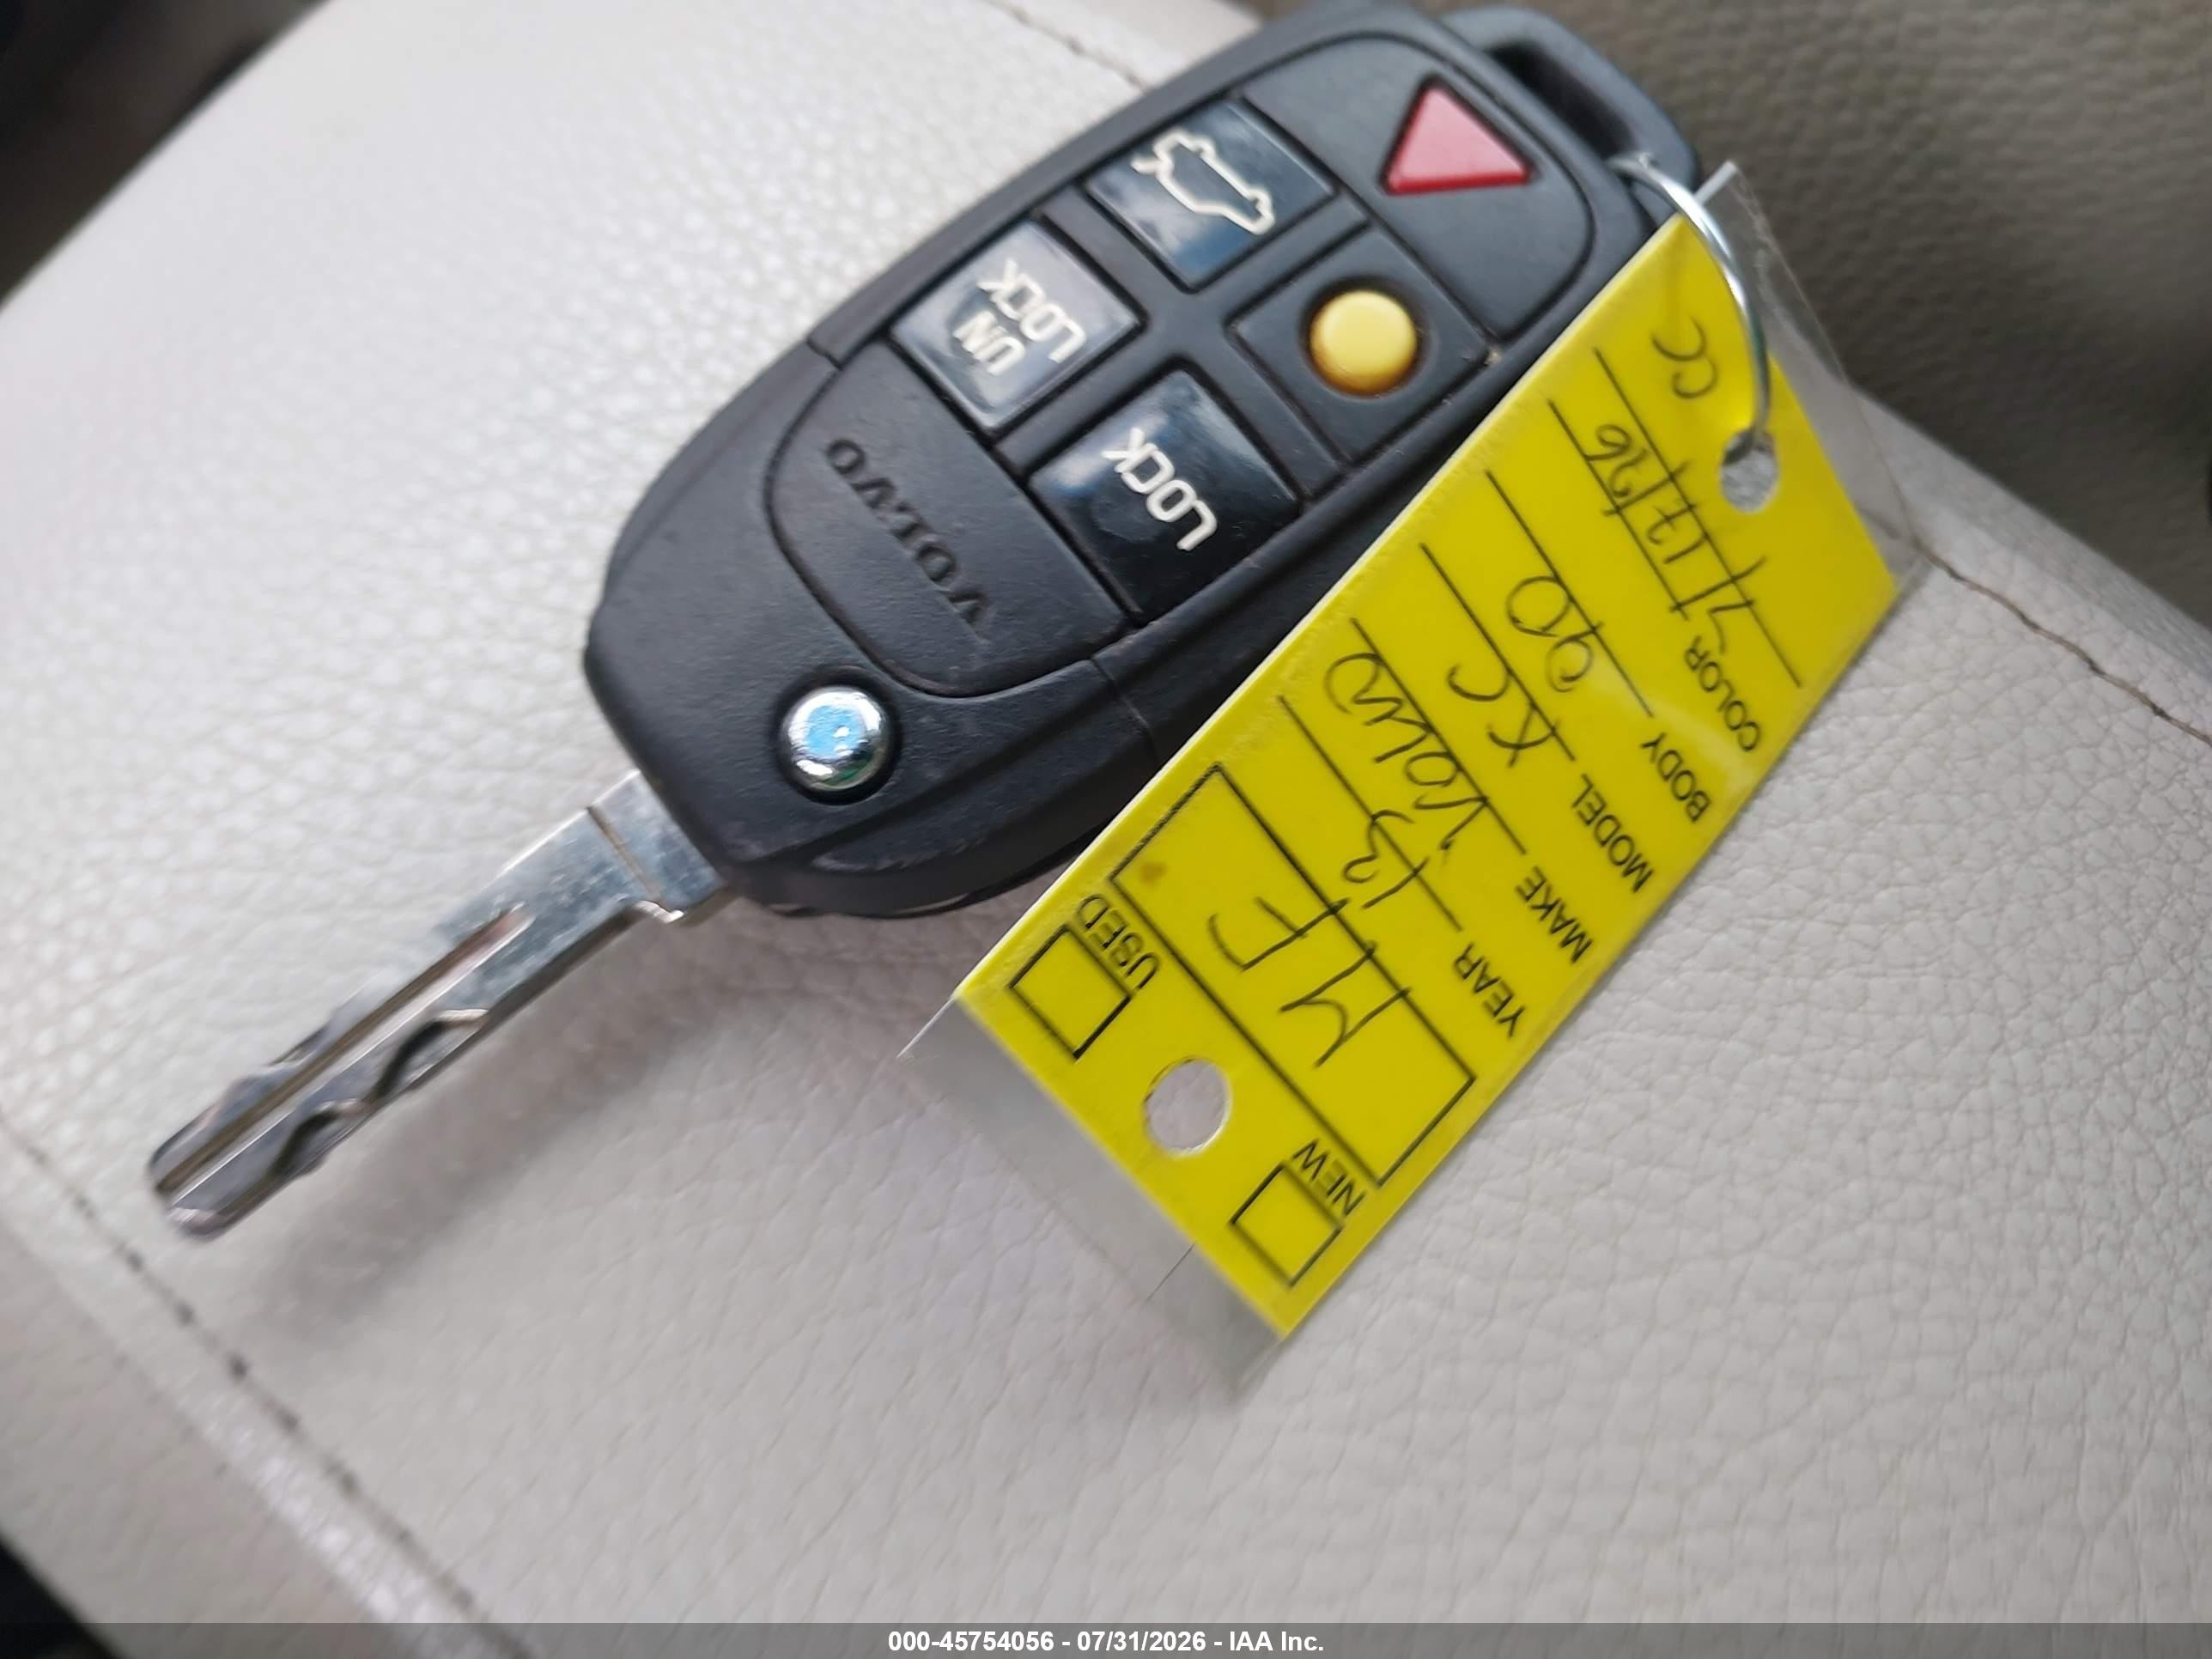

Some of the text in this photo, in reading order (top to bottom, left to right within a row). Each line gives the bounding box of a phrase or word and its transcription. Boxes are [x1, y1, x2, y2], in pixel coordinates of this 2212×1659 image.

[951, 310, 1025, 376] UN
[978, 259, 1086, 363] LOCK
[823, 438, 994, 630] VOLVO
[1101, 427, 1218, 552] LOCK
[1505, 575, 1603, 692] 90
[1683, 635, 1762, 751] COLOR
[1640, 732, 1711, 823] BODY
[1341, 809, 1431, 910] 13
[1571, 774, 1655, 893] MODEL
[1077, 892, 1160, 990] USED
[1515, 866, 1593, 964] MAKE
[1451, 944, 1526, 1037] YEAR
[1291, 1138, 1367, 1217] NEW
